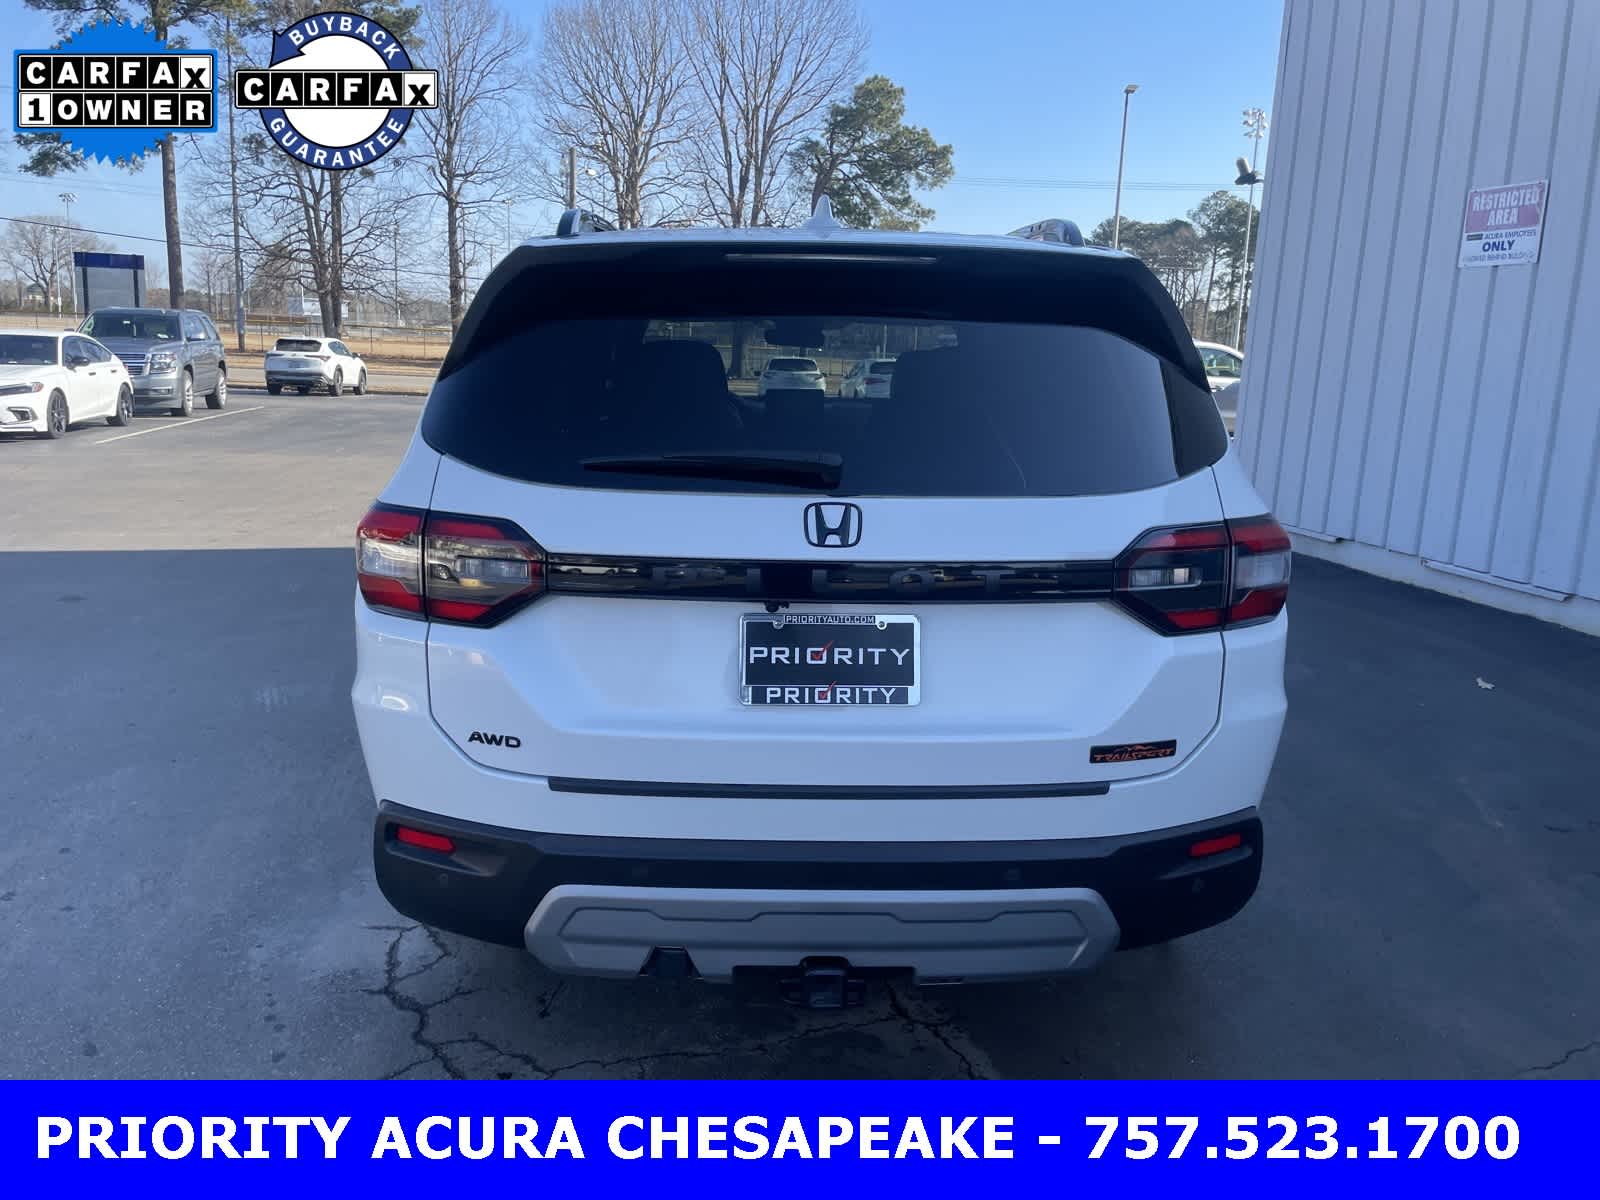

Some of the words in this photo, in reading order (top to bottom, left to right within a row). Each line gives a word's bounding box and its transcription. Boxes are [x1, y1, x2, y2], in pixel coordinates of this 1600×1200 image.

[1472, 187, 1540, 212] RESTRICTED
[1487, 207, 1519, 226] AREA
[1482, 240, 1516, 252] ONLY
[785, 615, 876, 624] PRIORITYAUTO.COM
[749, 646, 910, 666] PRIORITY
[766, 687, 897, 704] PRIORITY
[467, 731, 522, 748] AWD
